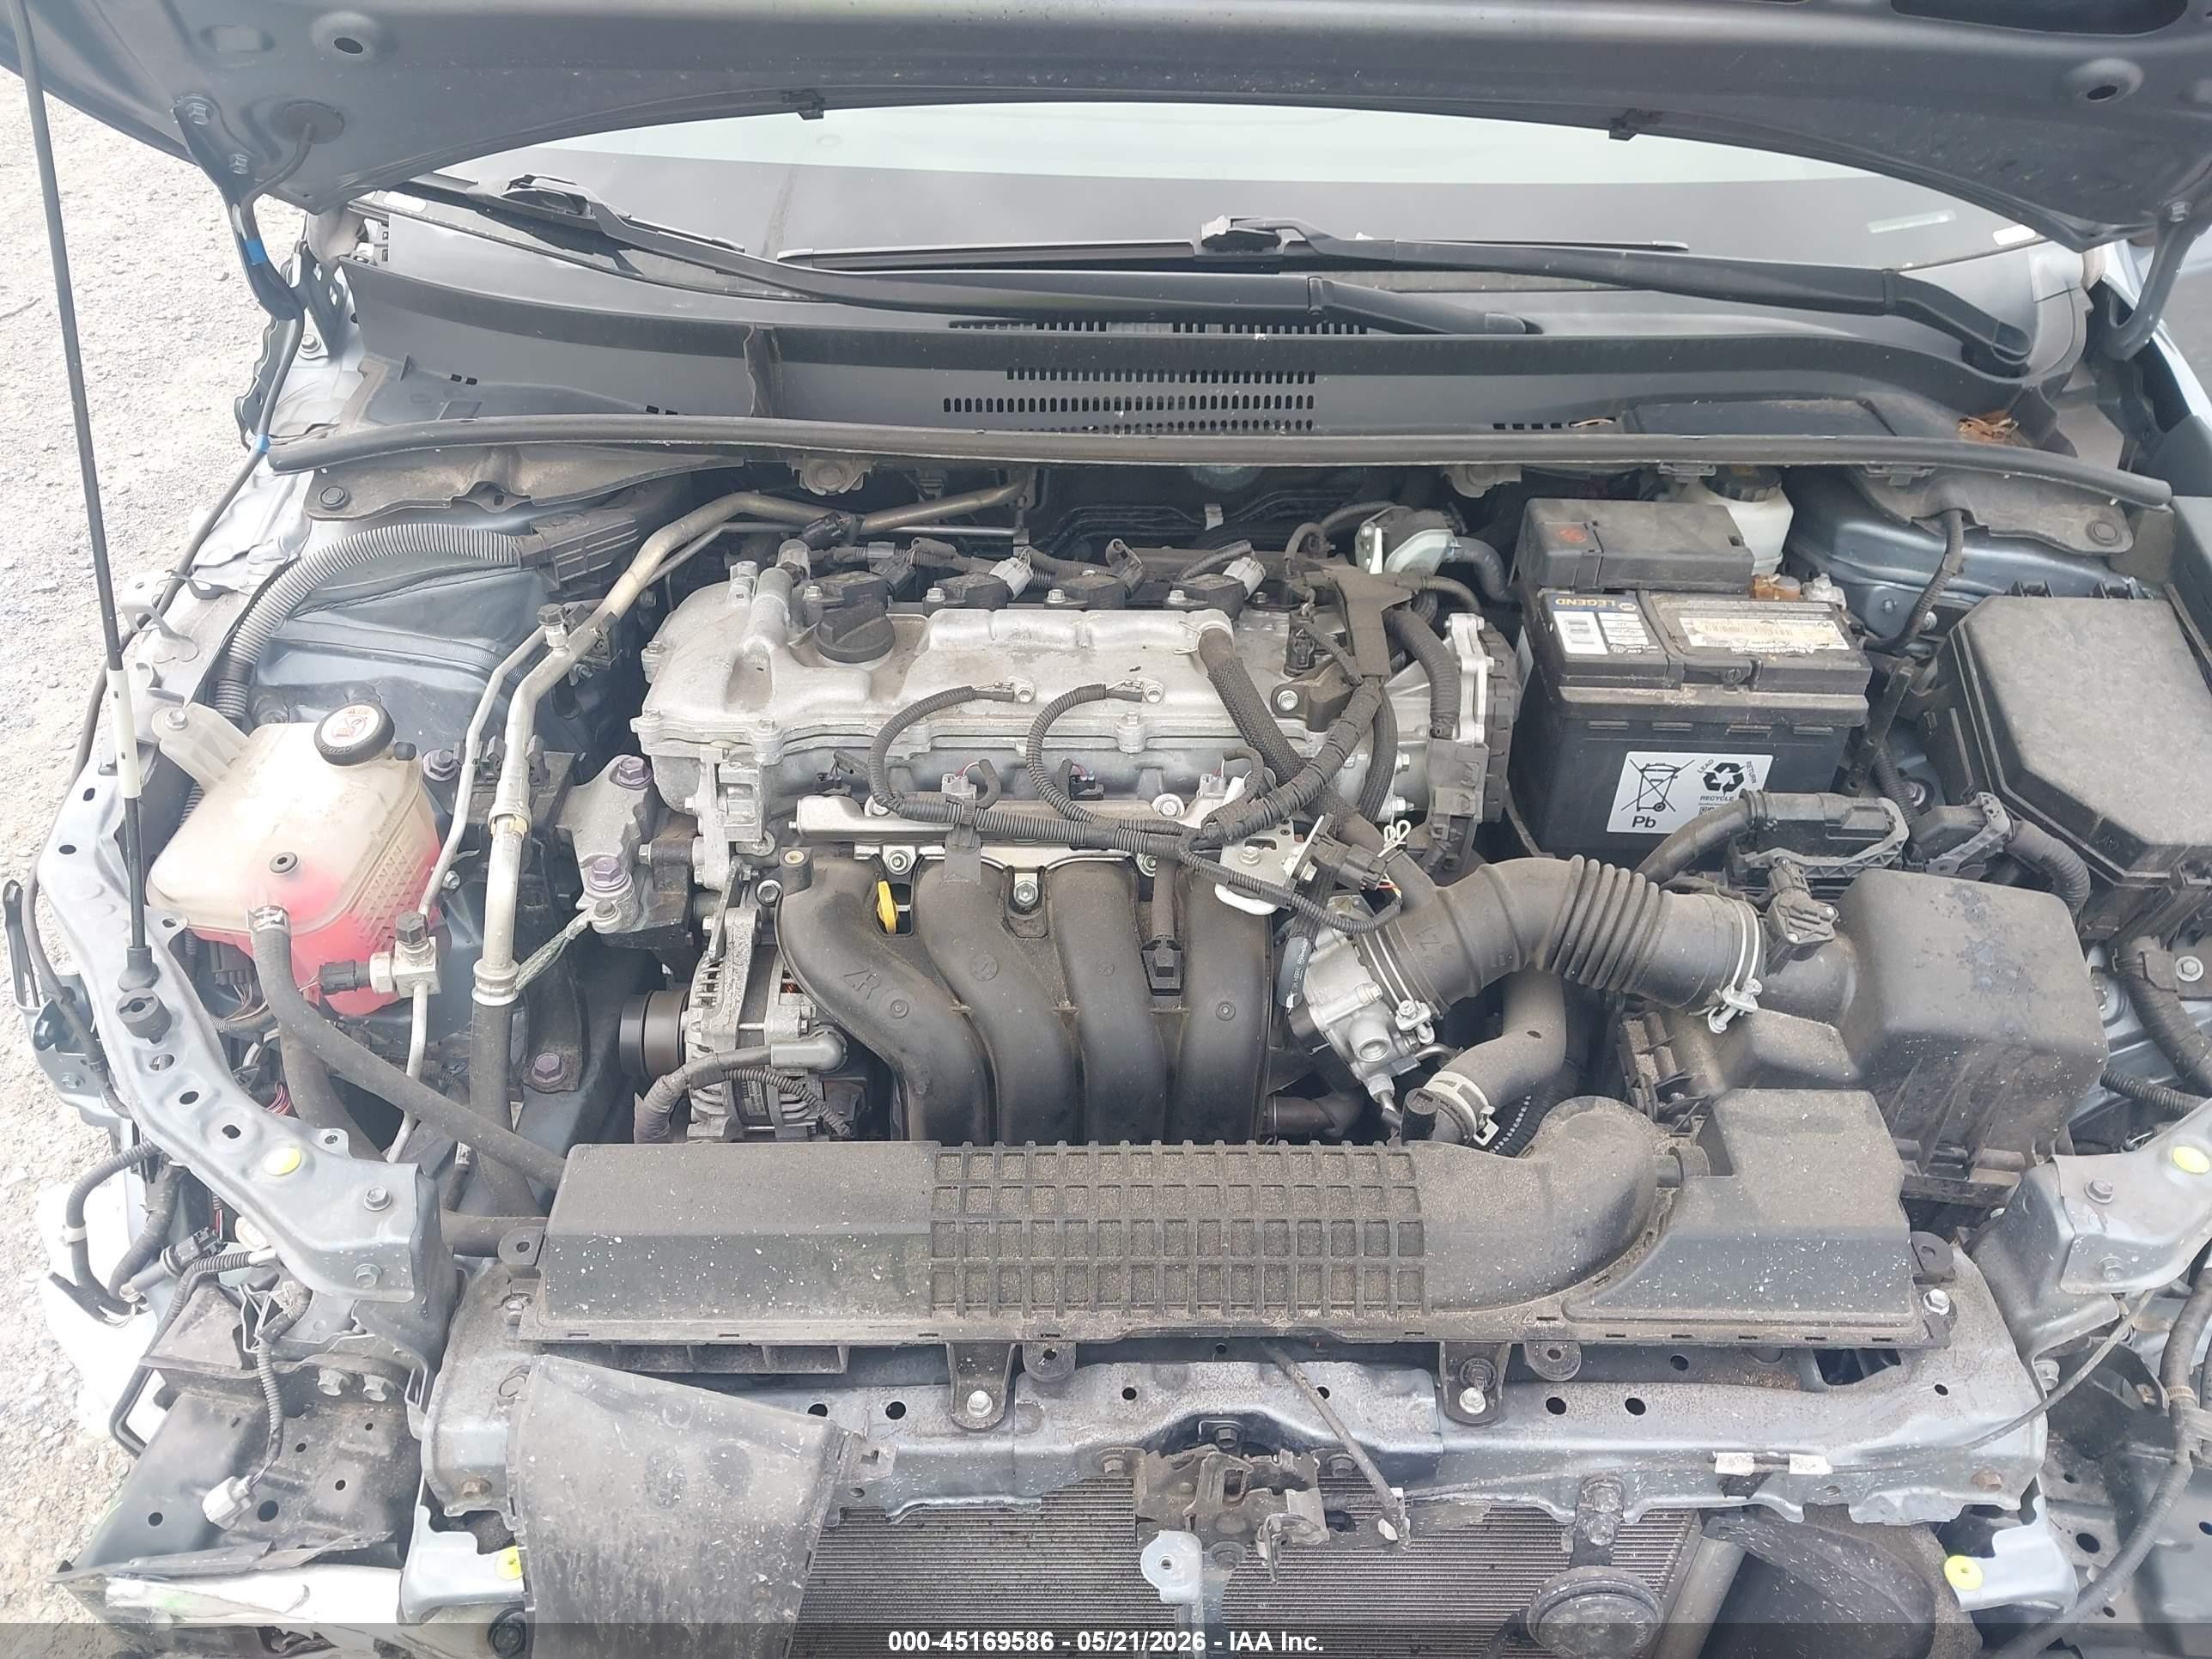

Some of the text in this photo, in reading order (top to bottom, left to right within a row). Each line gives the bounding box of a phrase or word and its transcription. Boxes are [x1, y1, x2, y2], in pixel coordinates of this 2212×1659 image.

[1555, 596, 1615, 607] LEGEND
[1698, 759, 1715, 775] LEAD
[1745, 761, 1758, 784] RETURN
[1631, 815, 1657, 830] Pb
